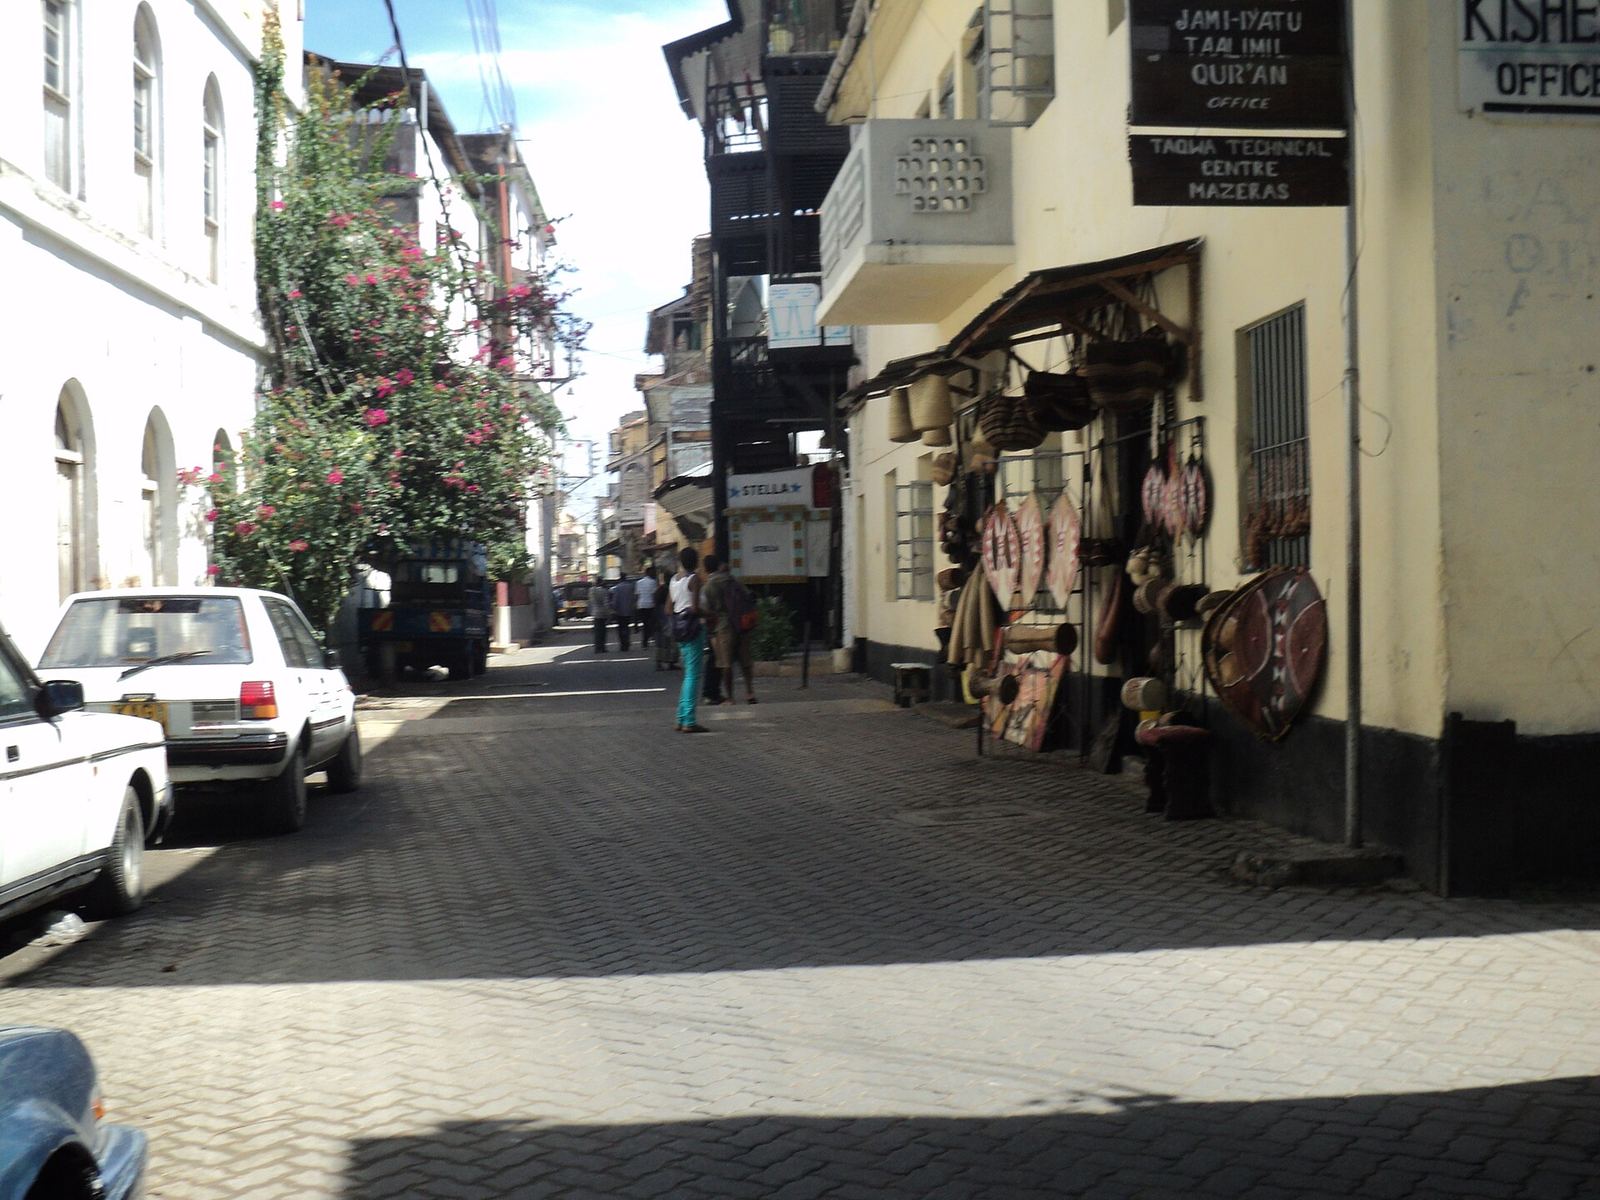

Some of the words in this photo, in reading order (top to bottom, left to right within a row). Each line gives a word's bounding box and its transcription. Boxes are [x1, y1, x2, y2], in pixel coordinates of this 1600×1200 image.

[1191, 63, 1288, 86] QUR'AN
[1207, 97, 1271, 109] OFFICE
[1151, 138, 1217, 154] TAQWA
[1225, 139, 1332, 157] TECHNICAL
[1202, 160, 1279, 177] CENTRE
[1189, 182, 1290, 200] MAZERAS
[743, 483, 789, 496] STELLA
